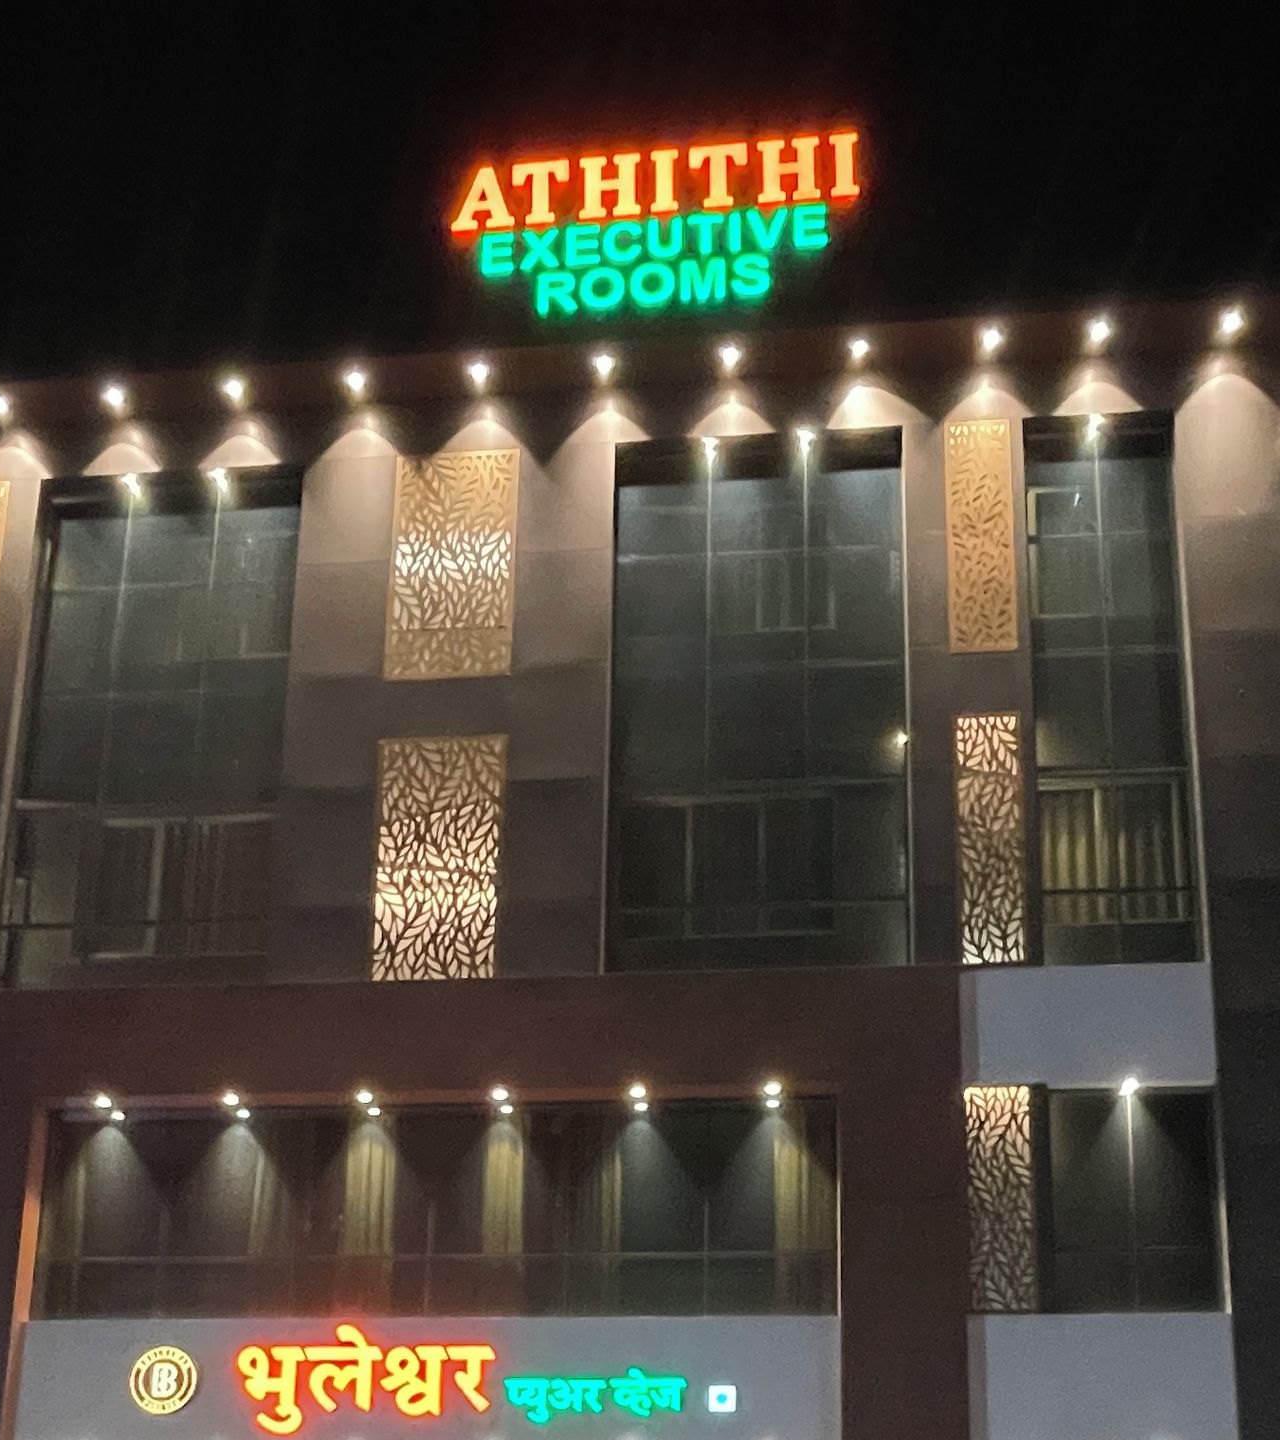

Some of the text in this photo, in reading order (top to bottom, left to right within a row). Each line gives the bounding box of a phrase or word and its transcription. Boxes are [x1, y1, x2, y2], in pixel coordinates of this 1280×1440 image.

[450, 131, 861, 233] ATHITHI
[479, 203, 830, 278] EXECUTIVE
[534, 254, 773, 318] ROOMS
[236, 1323, 496, 1435] भुलेश्वर
